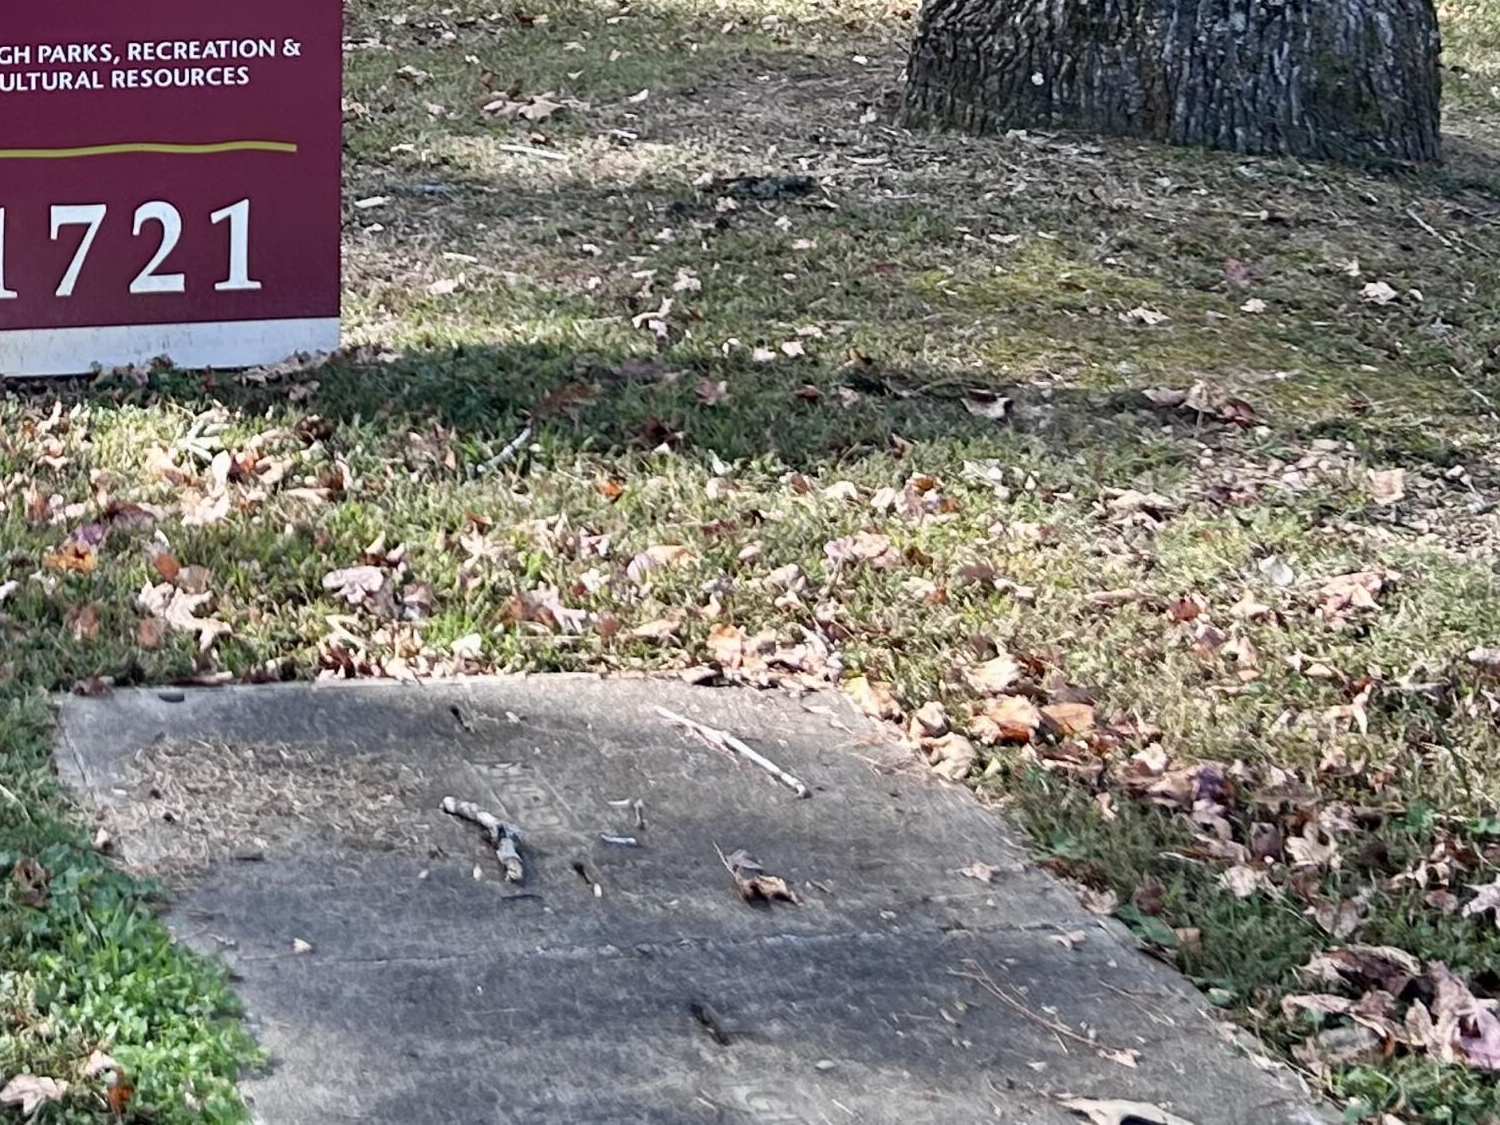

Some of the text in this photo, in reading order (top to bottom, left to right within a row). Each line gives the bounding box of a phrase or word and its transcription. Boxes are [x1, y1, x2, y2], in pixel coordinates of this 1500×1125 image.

[38, 43, 121, 66] PARKS,
[127, 39, 276, 62] RECREATION
[282, 38, 302, 58] &
[111, 66, 250, 89] RESOURCES
